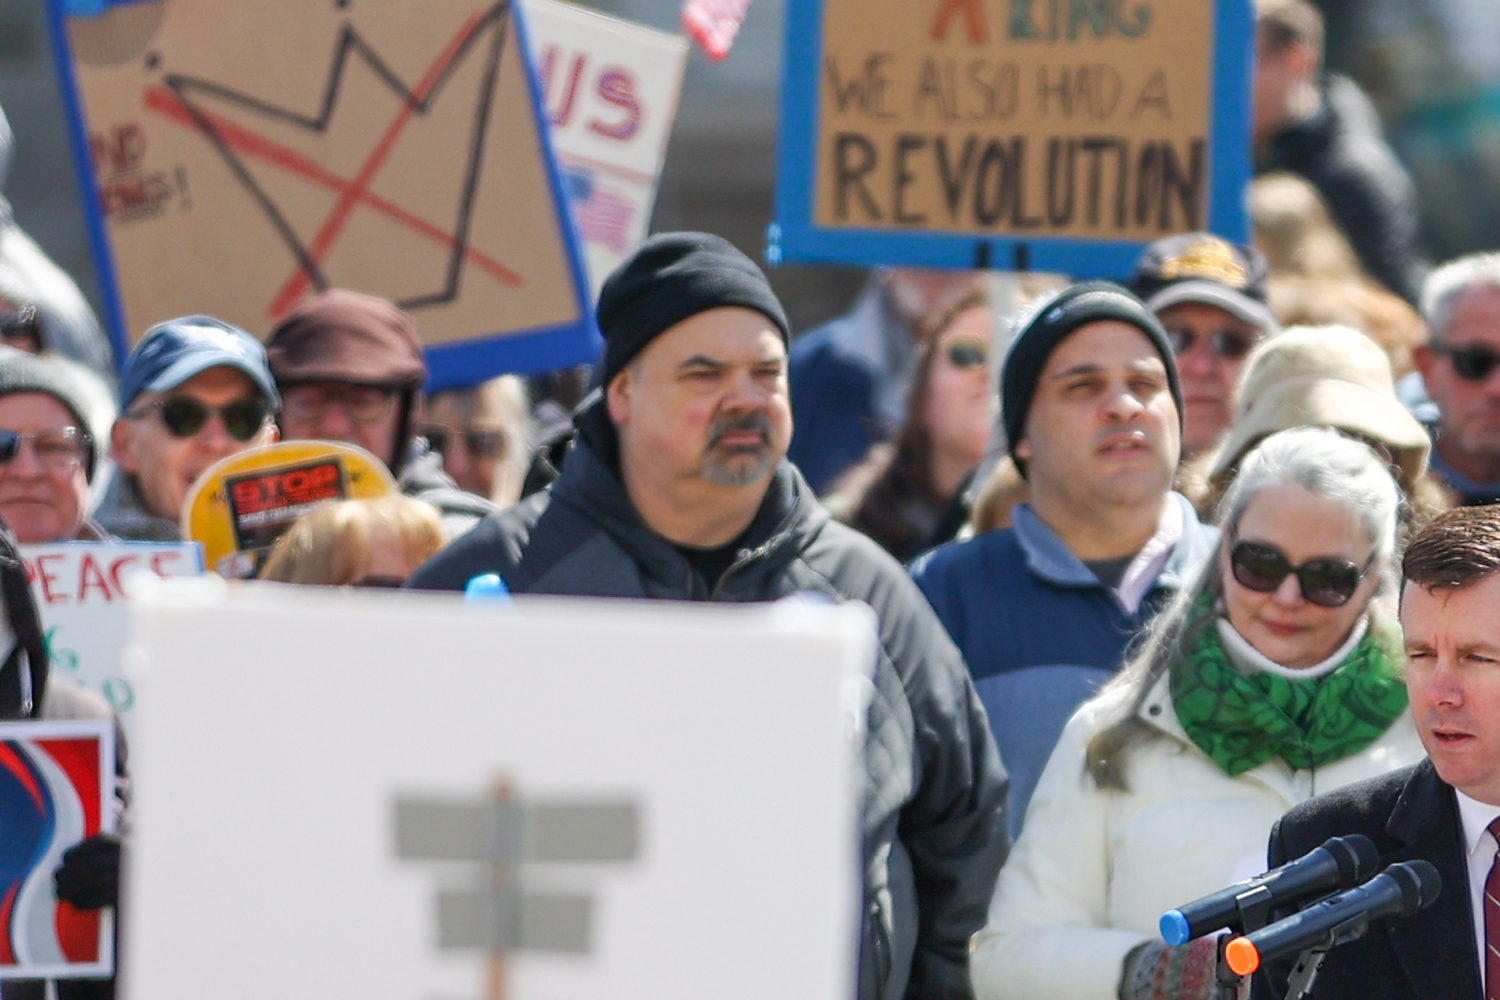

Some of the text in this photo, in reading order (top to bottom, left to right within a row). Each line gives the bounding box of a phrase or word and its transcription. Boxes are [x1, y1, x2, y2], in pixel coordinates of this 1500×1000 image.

[826, 52, 899, 123] WE
[1036, 64, 1123, 121] HAD
[1129, 66, 1172, 122] A
[834, 131, 1205, 231] REVOLUTION
